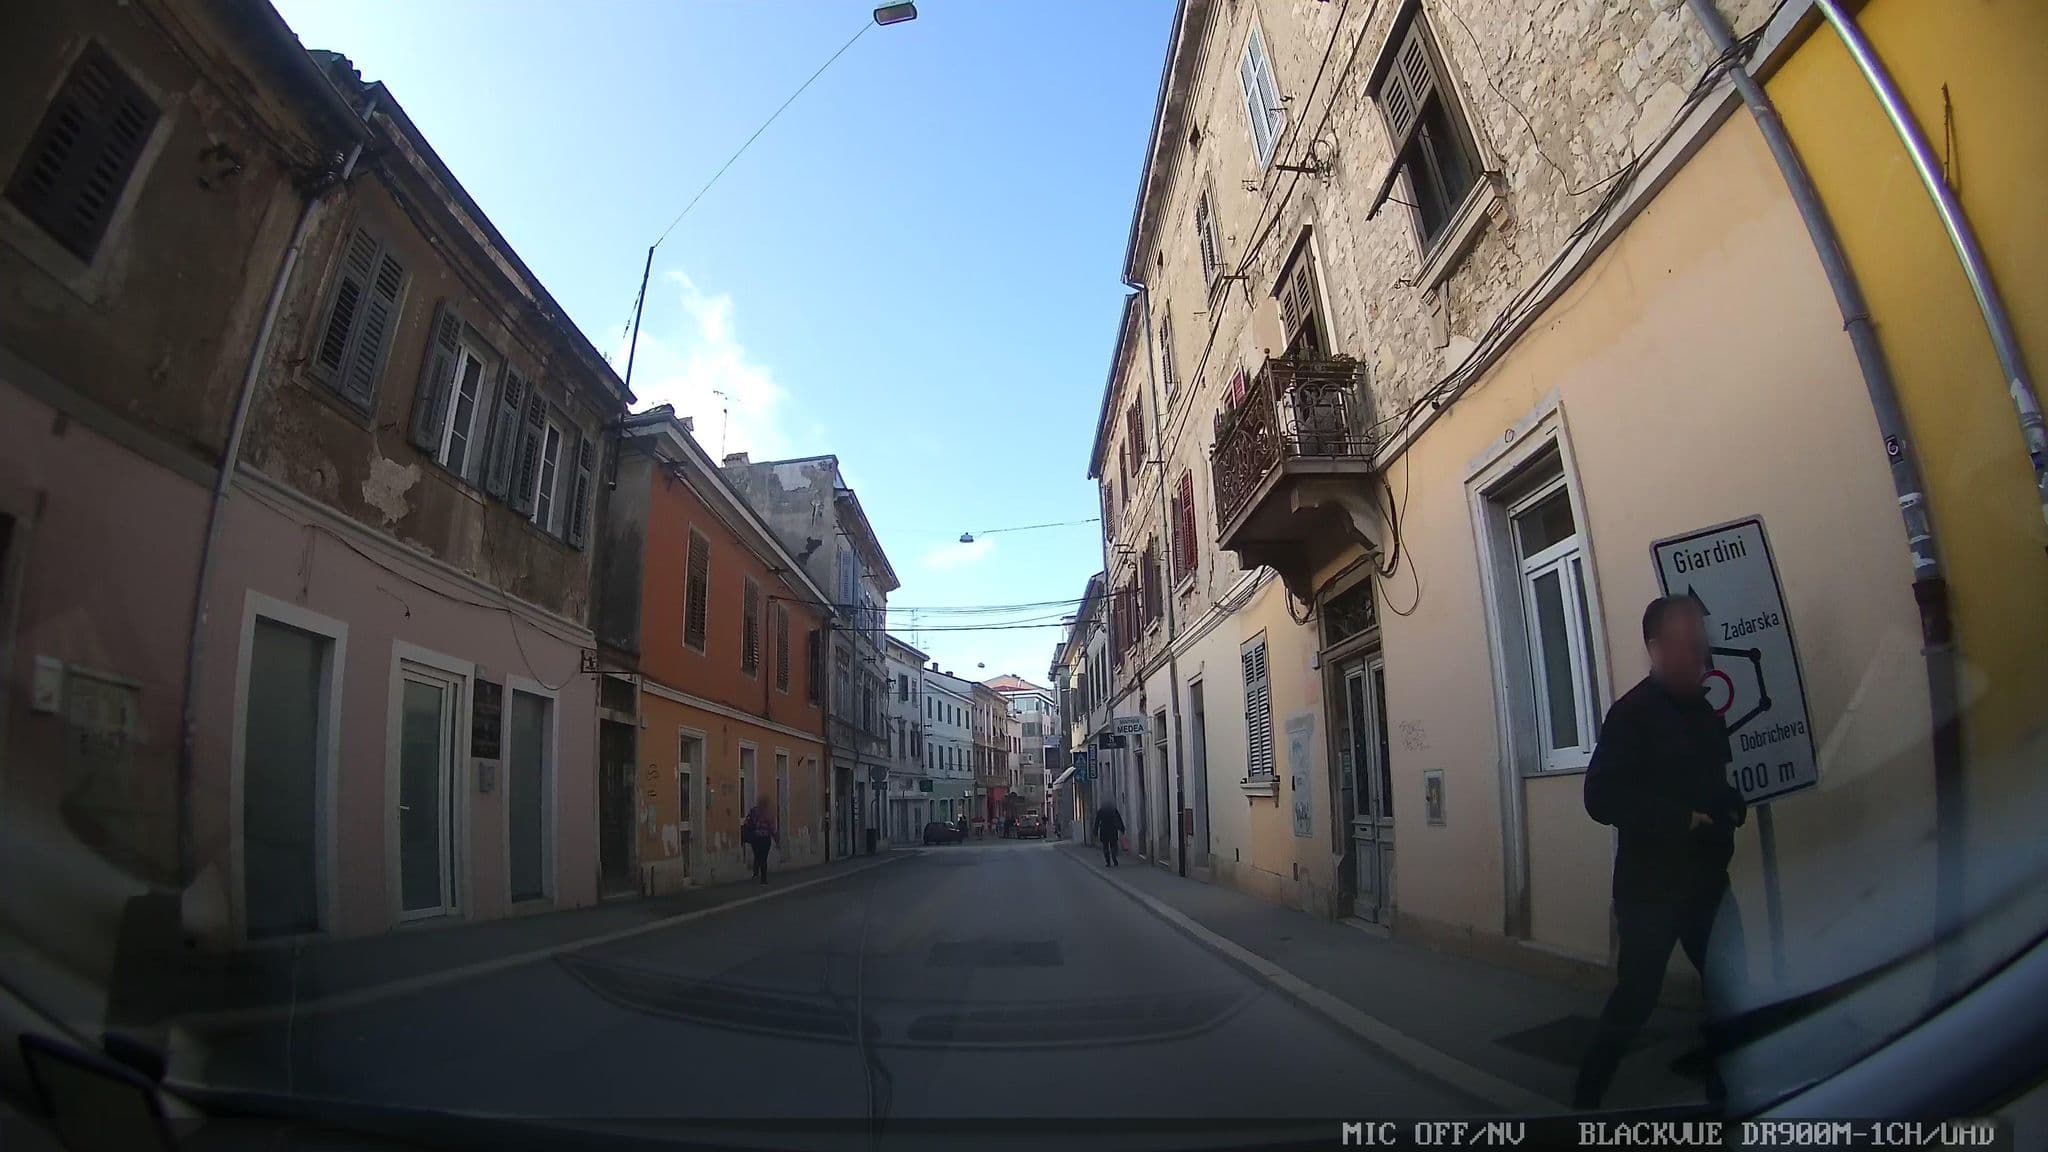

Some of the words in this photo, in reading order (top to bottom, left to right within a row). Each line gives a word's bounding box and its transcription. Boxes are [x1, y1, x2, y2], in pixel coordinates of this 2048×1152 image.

[1673, 535, 1747, 574] Giardini
[1721, 611, 1780, 641] Zadarska
[1117, 724, 1144, 733] MEDEA
[1740, 720, 1805, 752] Dobricheva
[1733, 762, 1769, 793] 100
[1778, 761, 1796, 783] m
